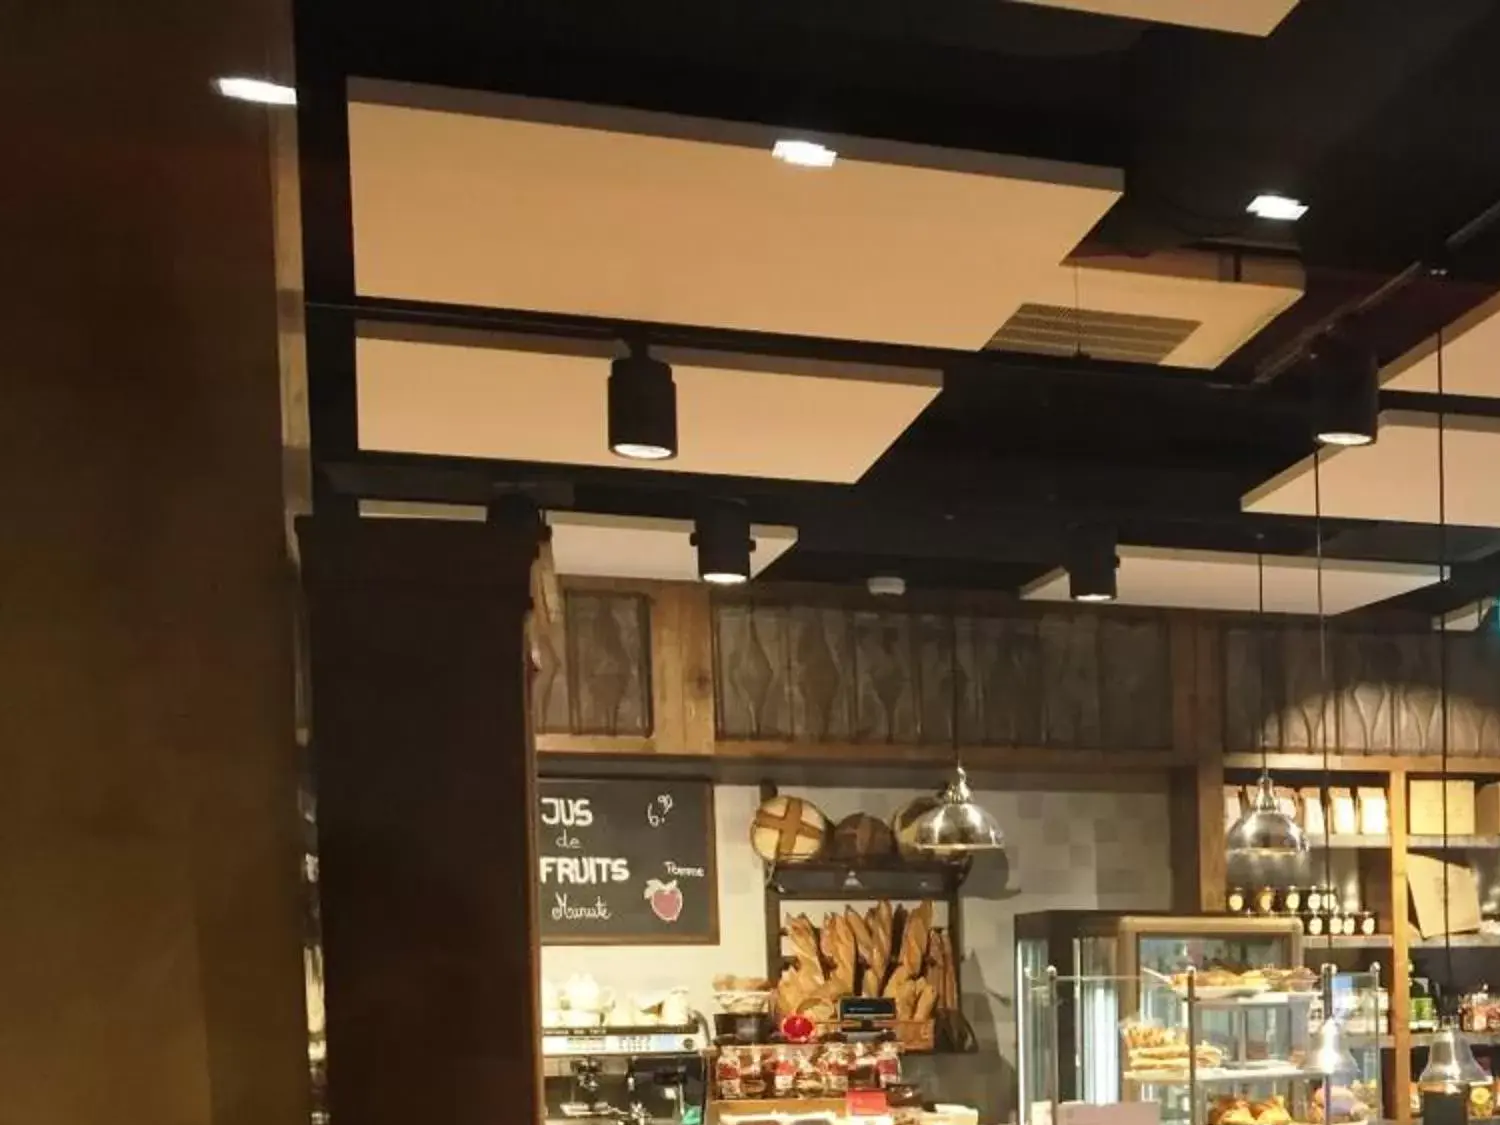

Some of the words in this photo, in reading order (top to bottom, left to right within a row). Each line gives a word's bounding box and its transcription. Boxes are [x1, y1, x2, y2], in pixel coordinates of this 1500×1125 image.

[541, 797, 593, 827] JUS
[555, 829, 581, 849] de
[539, 856, 631, 884] FRUITS
